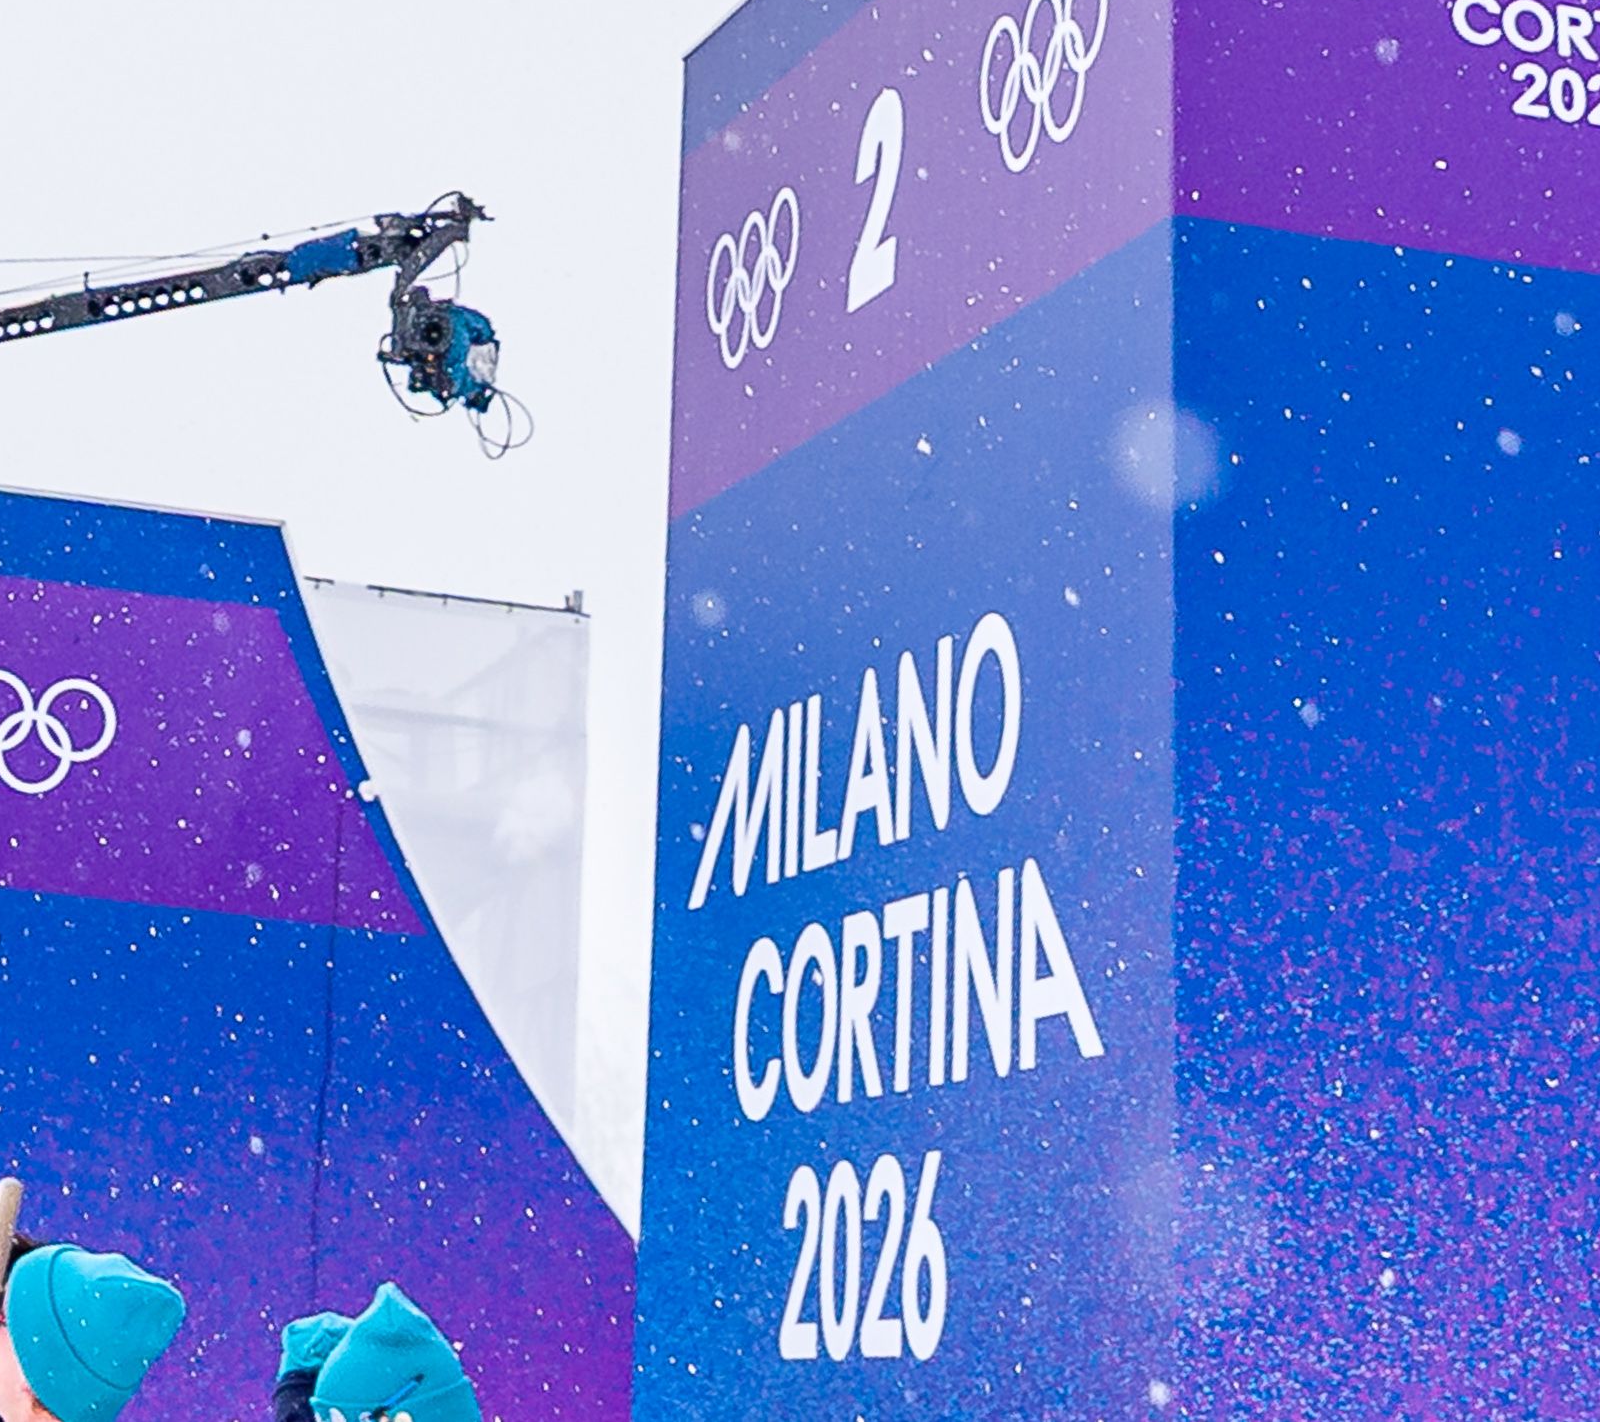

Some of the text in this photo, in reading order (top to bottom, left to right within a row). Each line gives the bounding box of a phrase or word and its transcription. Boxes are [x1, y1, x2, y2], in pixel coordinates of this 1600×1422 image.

[847, 87, 904, 313] 2
[688, 612, 1021, 910] MILANO
[733, 858, 1105, 1121] CORTINA
[779, 1151, 948, 1360] 2026
